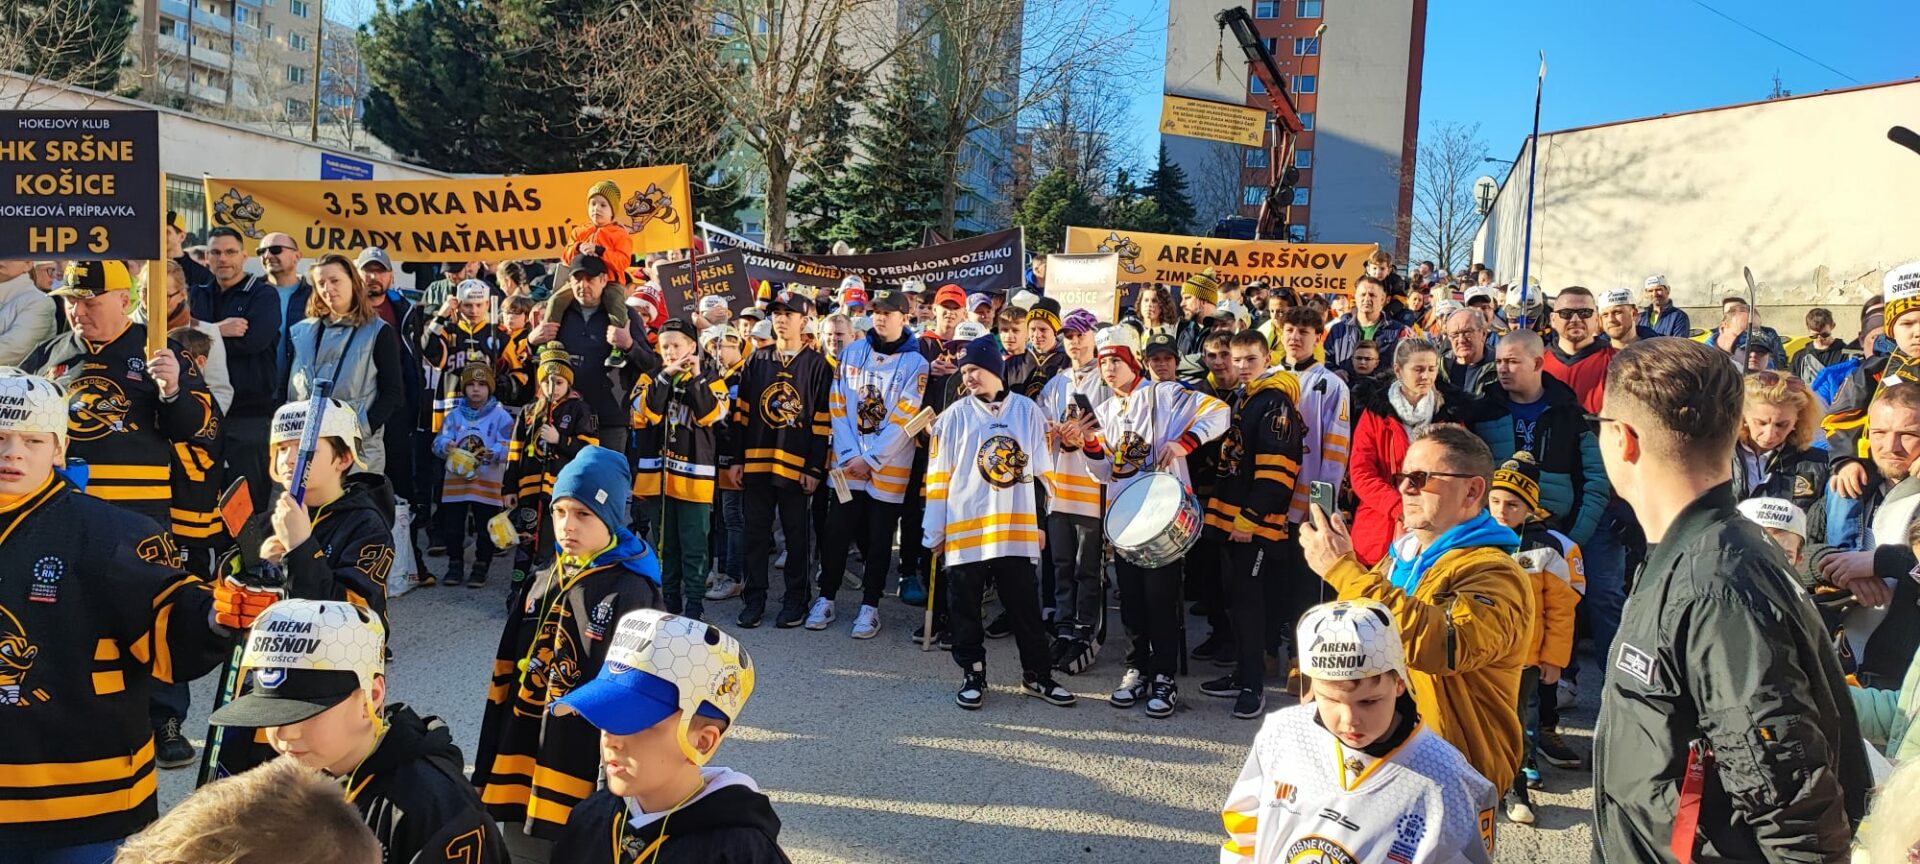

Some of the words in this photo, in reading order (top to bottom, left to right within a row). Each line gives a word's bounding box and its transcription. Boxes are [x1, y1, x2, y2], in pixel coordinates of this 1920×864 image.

[19, 117, 79, 129] HOKEJOVÝ
[82, 119, 110, 129] KLUB
[0, 141, 37, 162] HK
[45, 134, 134, 162] SRŠNE
[15, 168, 115, 195] KOŠICE
[68, 203, 136, 217] PRÍPRAVKA
[323, 192, 369, 218] 3,5
[376, 191, 466, 217] ROKA
[473, 182, 542, 213] NÁS
[29, 227, 78, 253] HP
[88, 227, 110, 253] 3
[305, 221, 402, 251] ÚRADY
[742, 252, 796, 272] ÝSTAVBU
[947, 264, 1004, 280] PLOCHOU
[867, 267, 878, 276] O
[880, 261, 950, 276] PRENÁJOM
[952, 247, 1012, 265] POZEMKU
[1157, 242, 1239, 267] ARÉNA
[1247, 247, 1348, 270] SRŠŇOV
[671, 274, 691, 287] HK
[1290, 273, 1347, 290] KOŠICE
[42, 569, 55, 578] RN
[267, 619, 313, 634] ARÉNA
[252, 634, 322, 655] SRŠŇOV
[266, 655, 299, 664] KOŠICE
[1404, 827, 1417, 839] RN
[1318, 839, 1354, 864] KOŠIC
